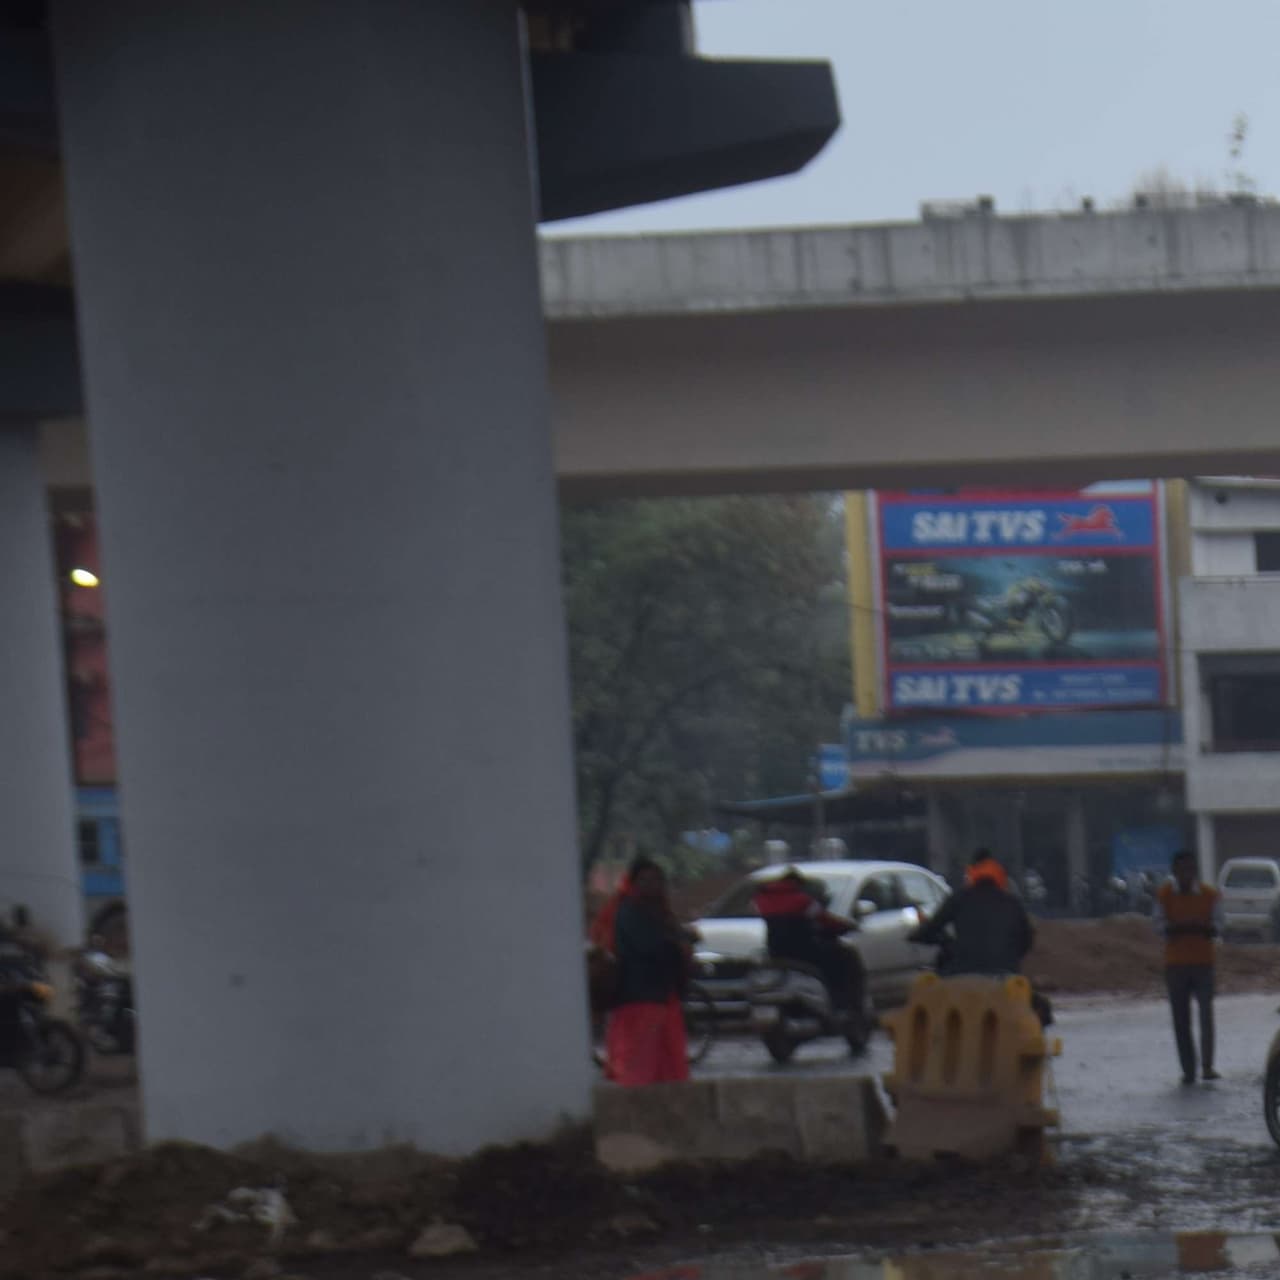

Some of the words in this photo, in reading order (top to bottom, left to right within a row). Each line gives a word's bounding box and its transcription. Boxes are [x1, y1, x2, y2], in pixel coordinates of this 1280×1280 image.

[912, 511, 968, 542] SAI
[972, 509, 1046, 542] TVS
[895, 675, 948, 703] SAI
[950, 674, 1022, 703] TVS
[855, 729, 908, 753] TVS
